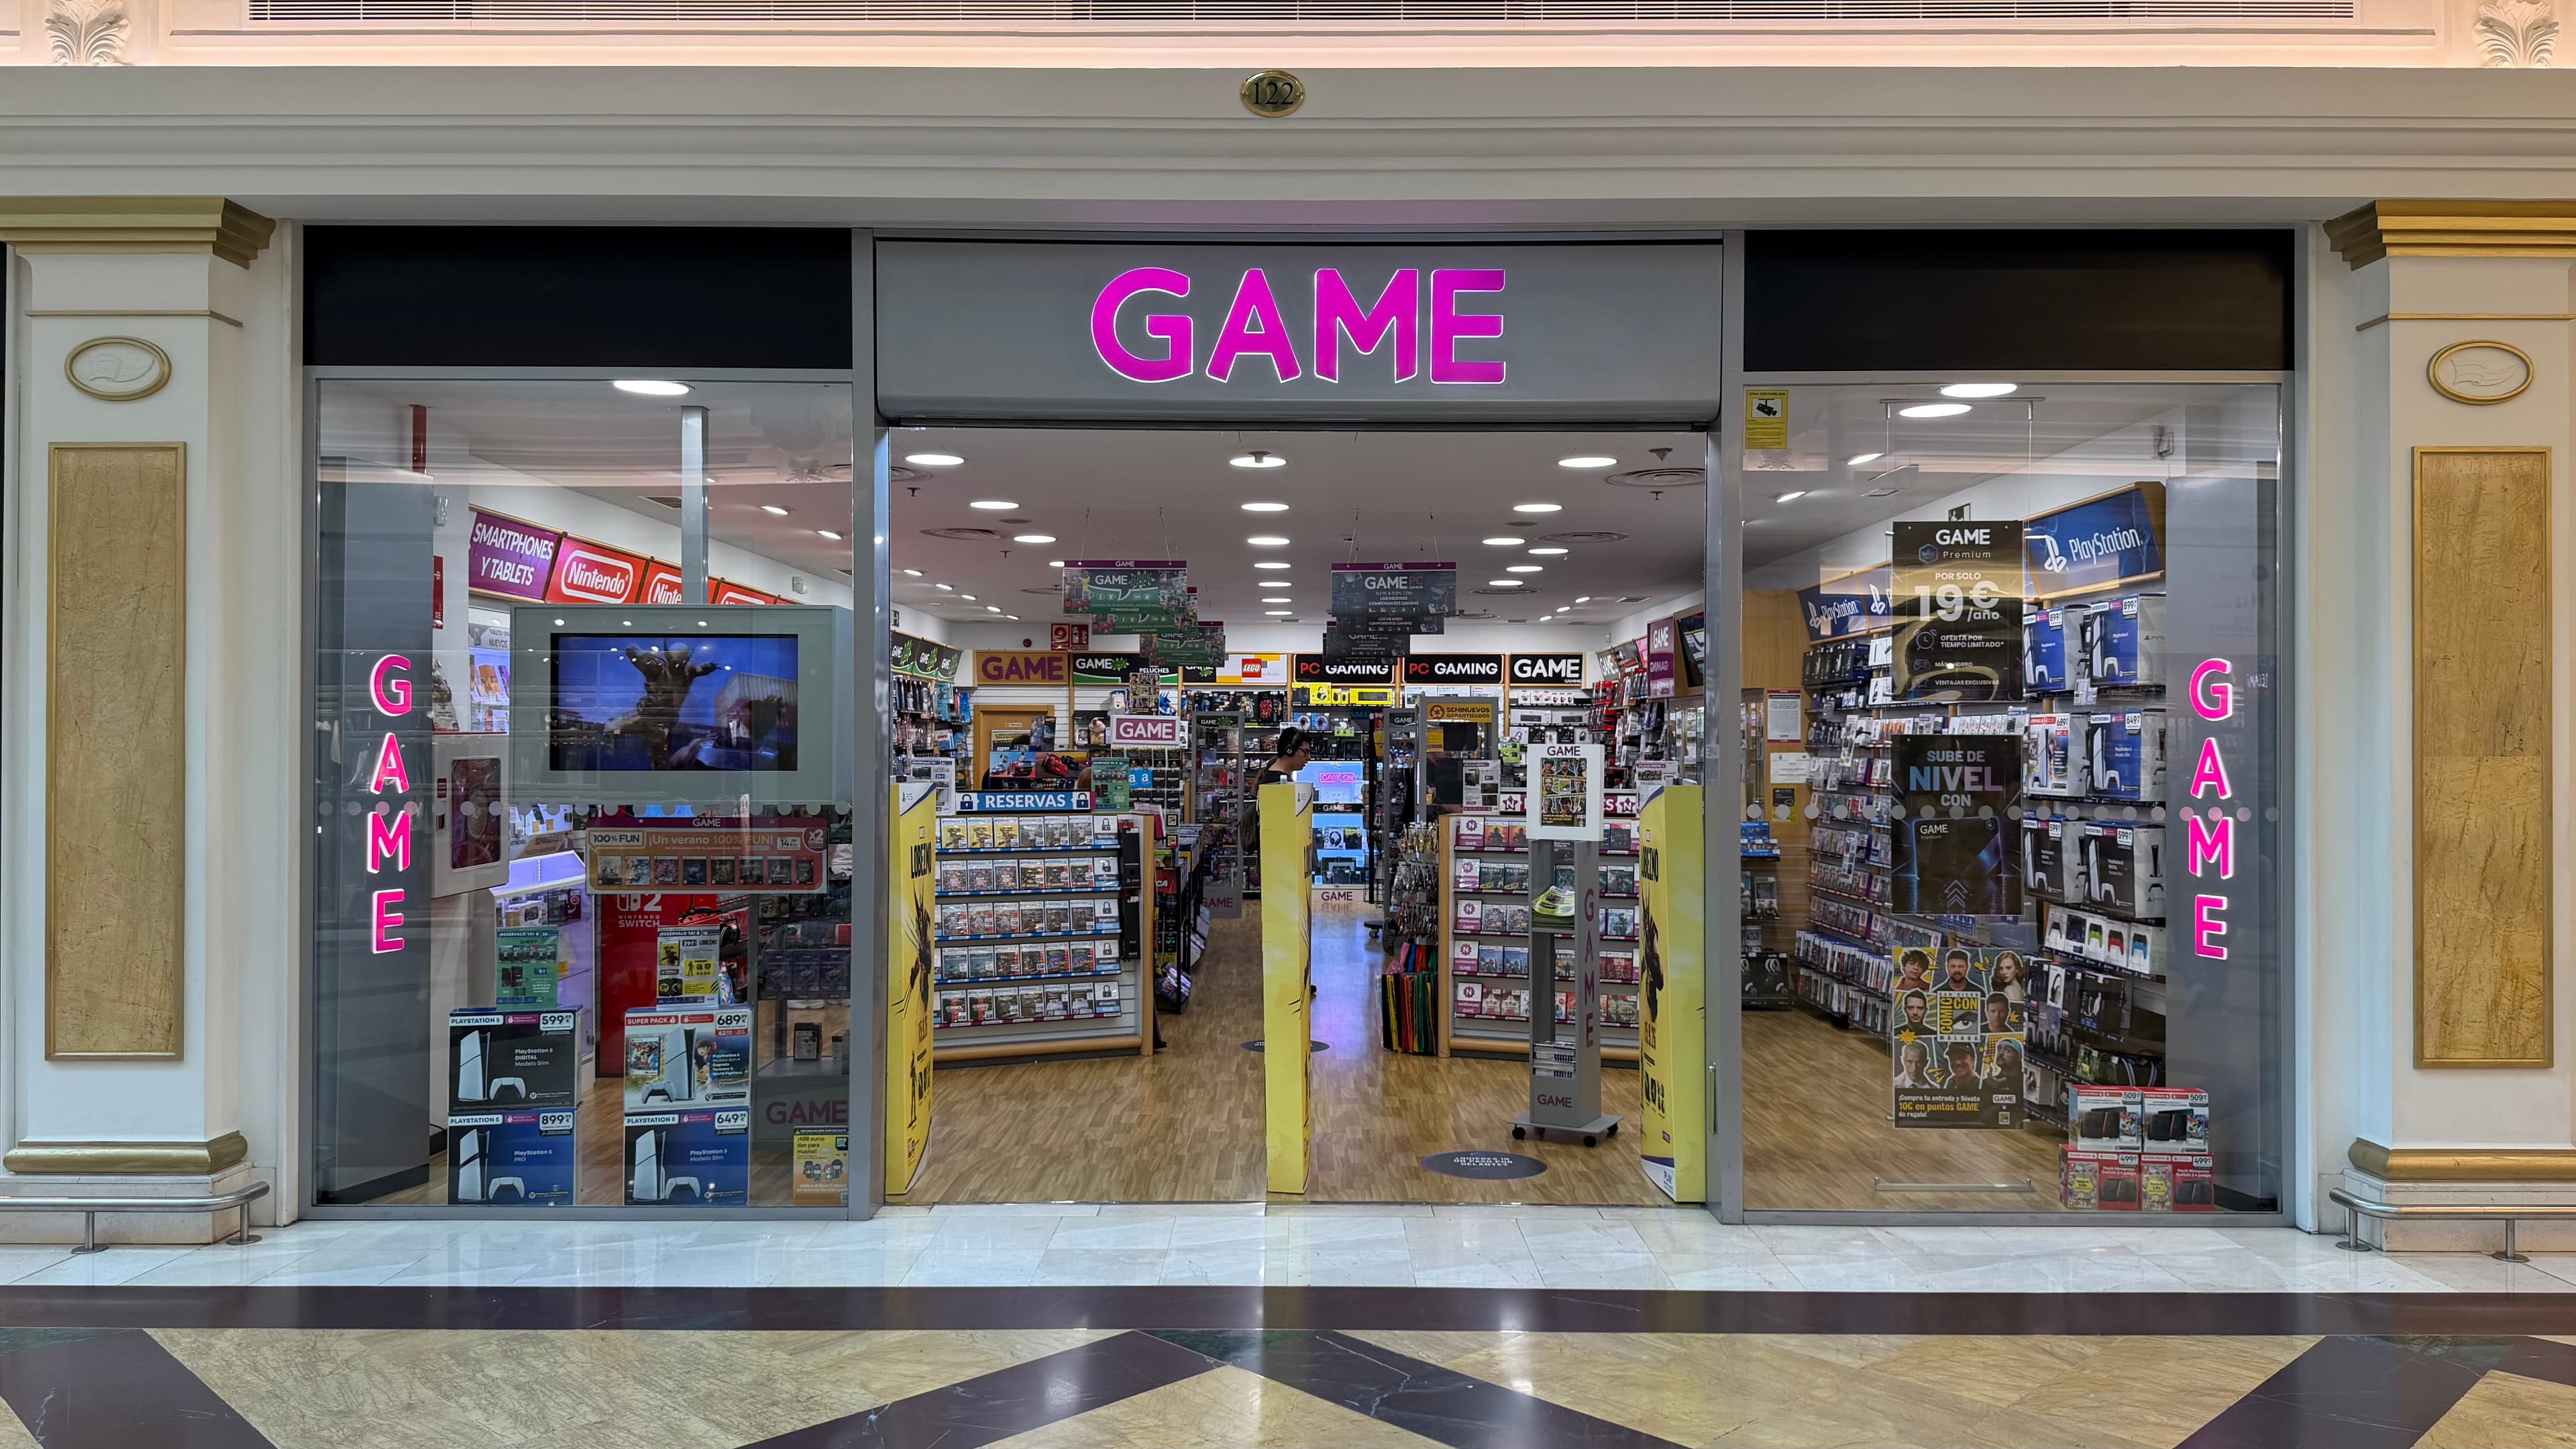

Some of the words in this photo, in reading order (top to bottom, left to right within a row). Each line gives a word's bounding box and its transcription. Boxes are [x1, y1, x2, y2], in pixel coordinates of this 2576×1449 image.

[1253, 82, 1294, 105] 122
[1091, 267, 1506, 384] GAME
[472, 523, 554, 560] SMARTPHONES
[1935, 529, 1991, 545] GAME
[2069, 527, 2141, 565] PlayStation
[1943, 551, 1991, 559] Premium
[481, 556, 491, 577] Y
[490, 558, 535, 586] TABLETS
[568, 561, 626, 595] Nintendo
[1957, 572, 1982, 580] SOLO
[1095, 575, 1128, 585] GAME
[1364, 576, 1408, 589] GAME
[1409, 576, 1423, 585] PC
[653, 582, 682, 604] Ninte
[1821, 599, 1859, 625] PlayStation
[1653, 627, 1669, 649] GAME
[981, 656, 1064, 680] GAME
[1075, 658, 1112, 669] GAME
[1300, 663, 1320, 674] PC
[1326, 665, 1389, 675] GAMING
[1409, 663, 1429, 675] PC
[1434, 663, 1498, 675] GAMING
[1514, 659, 1580, 678] GAME
[1119, 722, 1173, 739] GAME
[1547, 746, 1580, 756] GAME
[1927, 751, 1964, 762] SUBE
[1967, 751, 1985, 762] DE
[1909, 766, 2004, 791] NIVEL
[367, 654, 413, 955] GAME
[985, 792, 1065, 808] RESERVAS
[1941, 794, 1971, 806] CON
[2188, 658, 2234, 961] GAME
[692, 818, 721, 826] GAME
[1920, 824, 1948, 835] GAME
[594, 835, 618, 843] 100%
[619, 835, 639, 843] FUN
[649, 836, 667, 846] ¡Un
[1322, 892, 1353, 901] GAME
[619, 920, 660, 928] SWITCH
[1584, 888, 1595, 1048] GAME
[1953, 998, 1978, 1010] CON
[1940, 998, 1953, 1034] COMIC
[1537, 1095, 1572, 1108] GAME
[1898, 1094, 1923, 1102] ¡Compra
[765, 1100, 848, 1124] GAME
[1898, 1102, 1913, 1111] 10€
[1927, 1103, 1954, 1112] puntos
[1956, 1102, 1979, 1111] GAME
